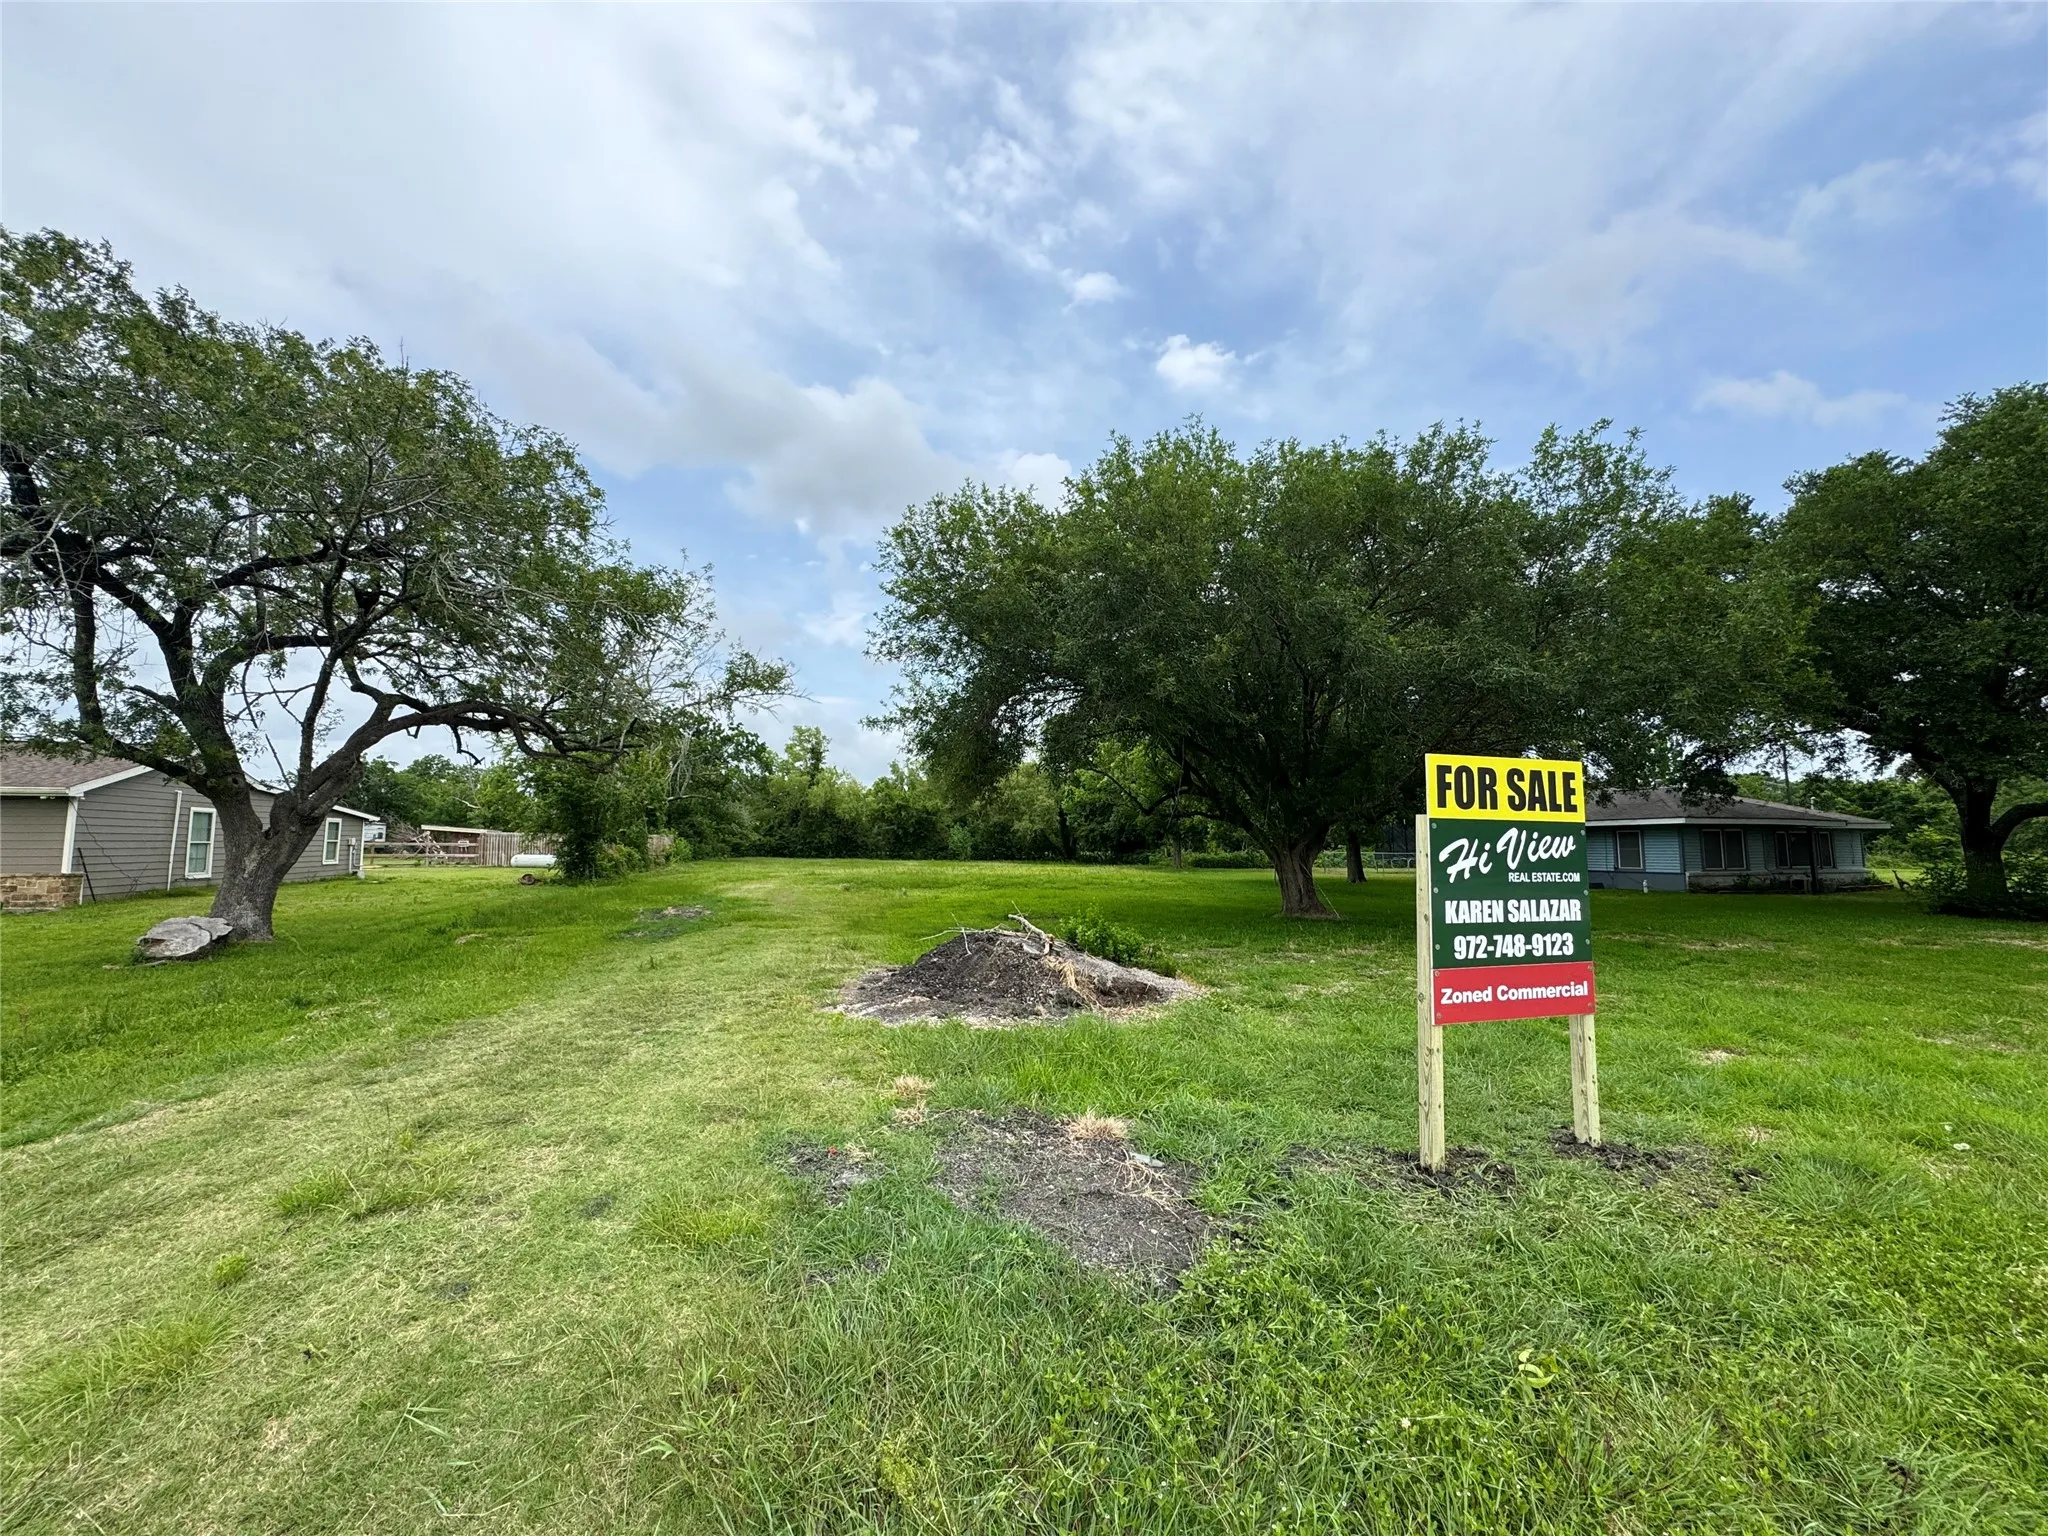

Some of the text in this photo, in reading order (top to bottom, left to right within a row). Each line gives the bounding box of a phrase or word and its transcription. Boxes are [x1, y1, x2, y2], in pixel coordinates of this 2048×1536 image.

[1436, 764, 1578, 813] FOR SALE
[1438, 827, 1576, 884] Hi View
[1508, 872, 1580, 883] REAL ESTATE.COM
[1445, 899, 1582, 924] KAREN SALAZAR
[1453, 932, 1574, 960] 972-748-9123
[1440, 981, 1588, 1004] Zoned Commercial
